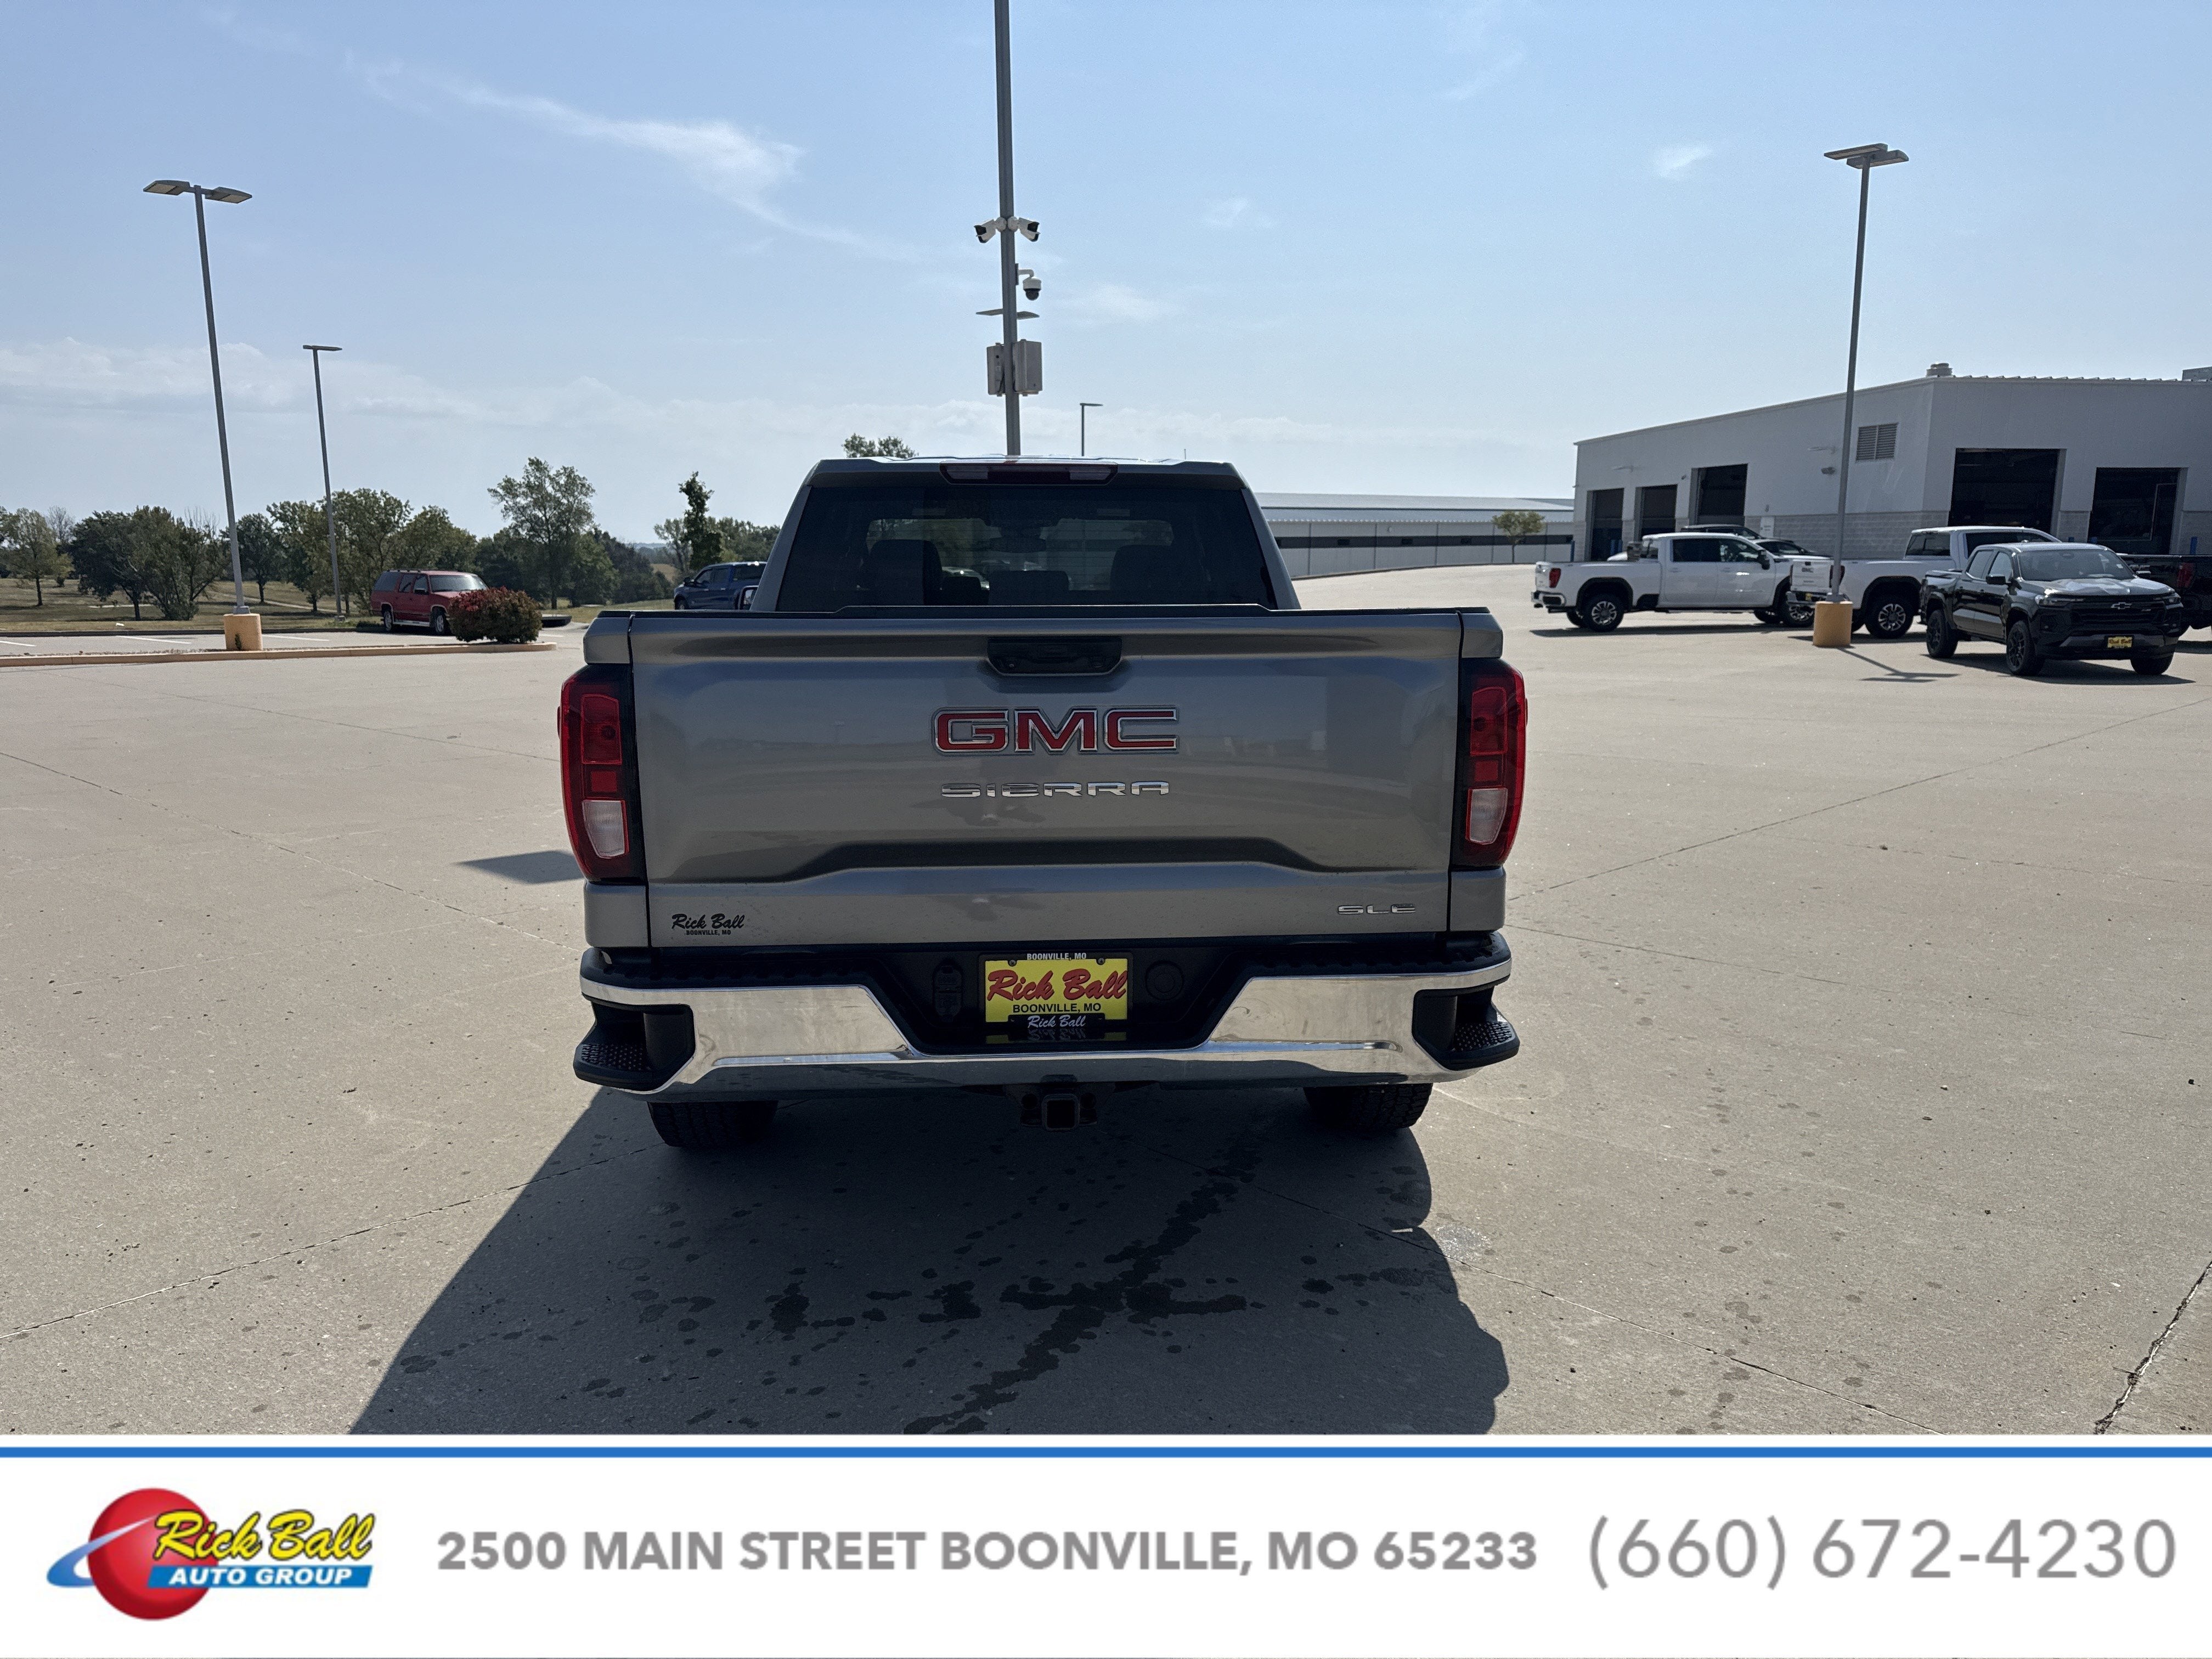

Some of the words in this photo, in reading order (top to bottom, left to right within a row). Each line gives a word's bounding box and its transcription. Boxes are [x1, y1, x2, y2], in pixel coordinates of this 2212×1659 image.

[935, 709, 1177, 753] GMC
[941, 781, 1170, 798] SIERRA
[1338, 904, 1415, 915] SLE
[672, 913, 707, 929] Rick
[710, 913, 745, 929] Ball
[987, 969, 1054, 1001] Rick
[1062, 968, 1127, 1000] Ball
[1013, 1003, 1080, 1013] BOONVILLE,
[1084, 1003, 1101, 1012] MO
[1028, 1015, 1056, 1029] Rick
[1059, 1014, 1086, 1028] Ball
